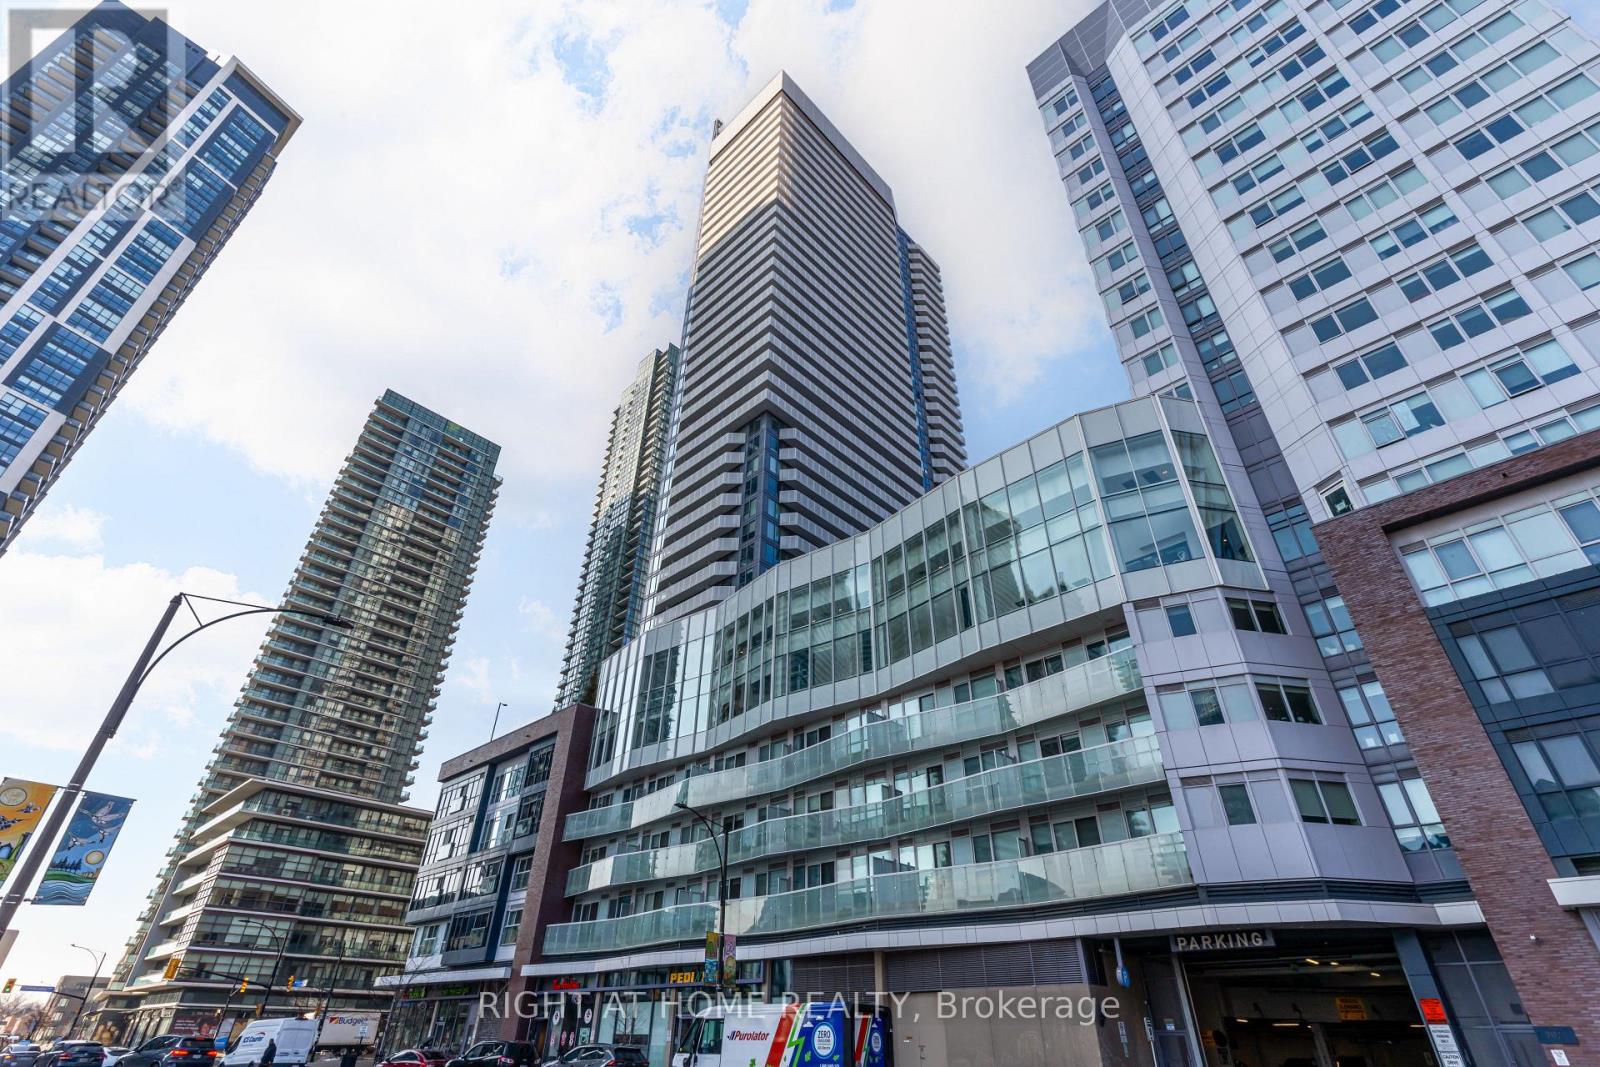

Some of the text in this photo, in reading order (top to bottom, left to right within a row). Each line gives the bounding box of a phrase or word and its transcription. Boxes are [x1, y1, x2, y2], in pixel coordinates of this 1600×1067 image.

[1177, 932, 1264, 951] PARKING
[670, 971, 695, 984] PEDI
[734, 1030, 770, 1041] Purolator
[817, 1030, 831, 1039] ZERO
